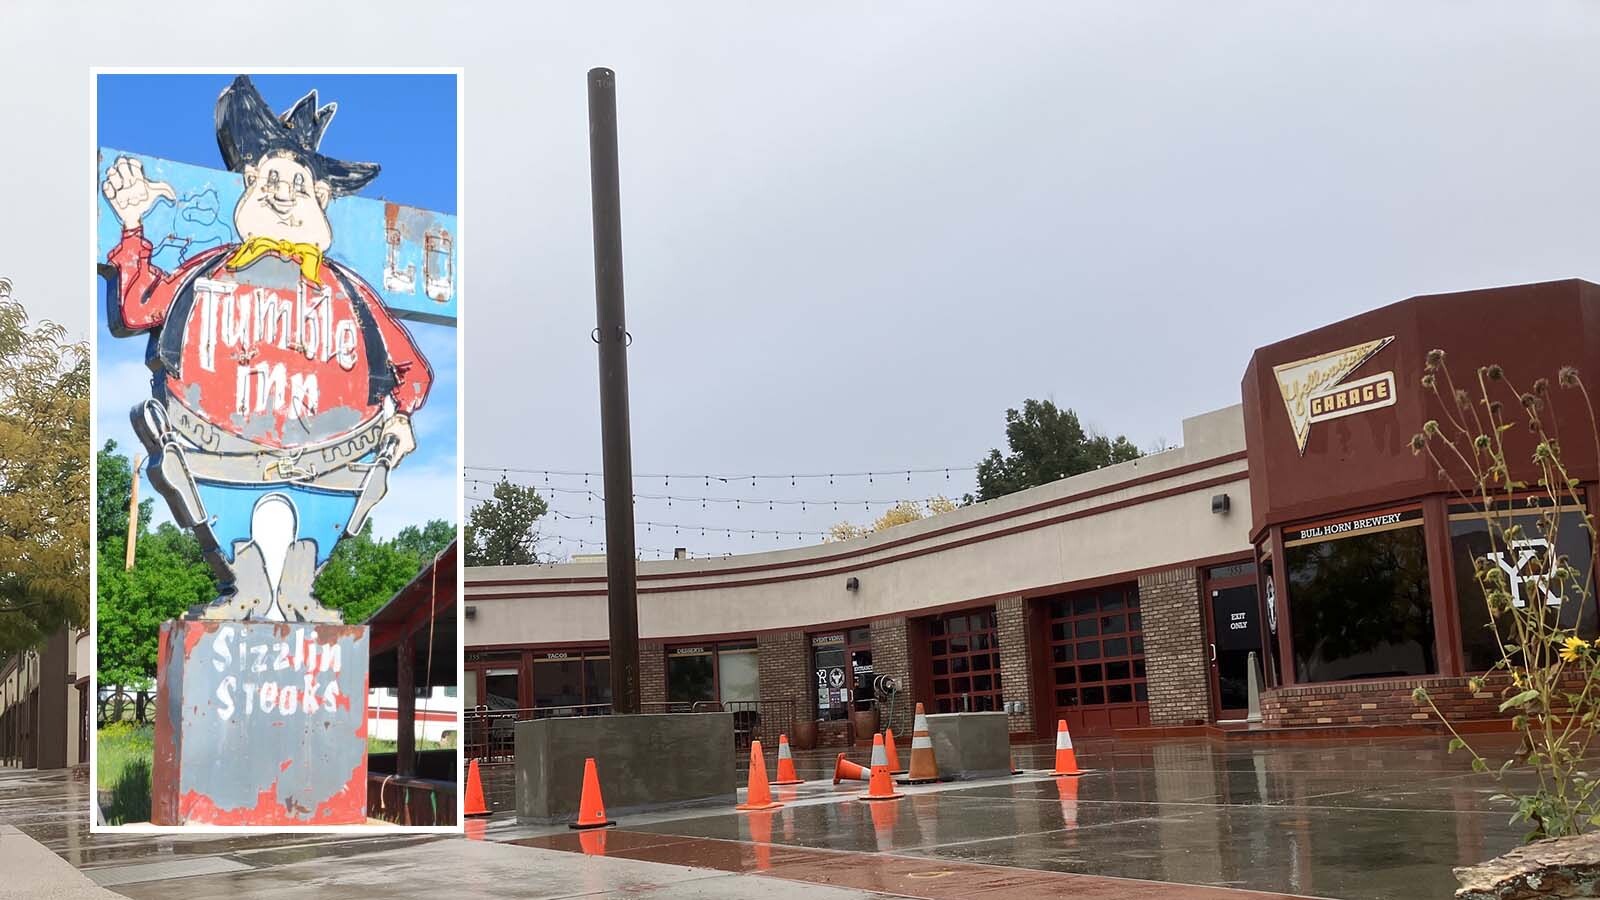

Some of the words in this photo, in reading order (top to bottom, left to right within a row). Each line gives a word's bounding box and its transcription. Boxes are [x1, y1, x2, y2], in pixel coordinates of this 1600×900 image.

[193, 277, 358, 373] Tumble
[1312, 382, 1387, 414] GARAGE
[1301, 528, 1323, 539] BULL
[1324, 521, 1352, 535] HORN
[1353, 513, 1402, 530] BREWERY
[1231, 621, 1247, 630] ONLY
[212, 626, 342, 673] Sizzlin
[216, 675, 339, 720] Steaks
